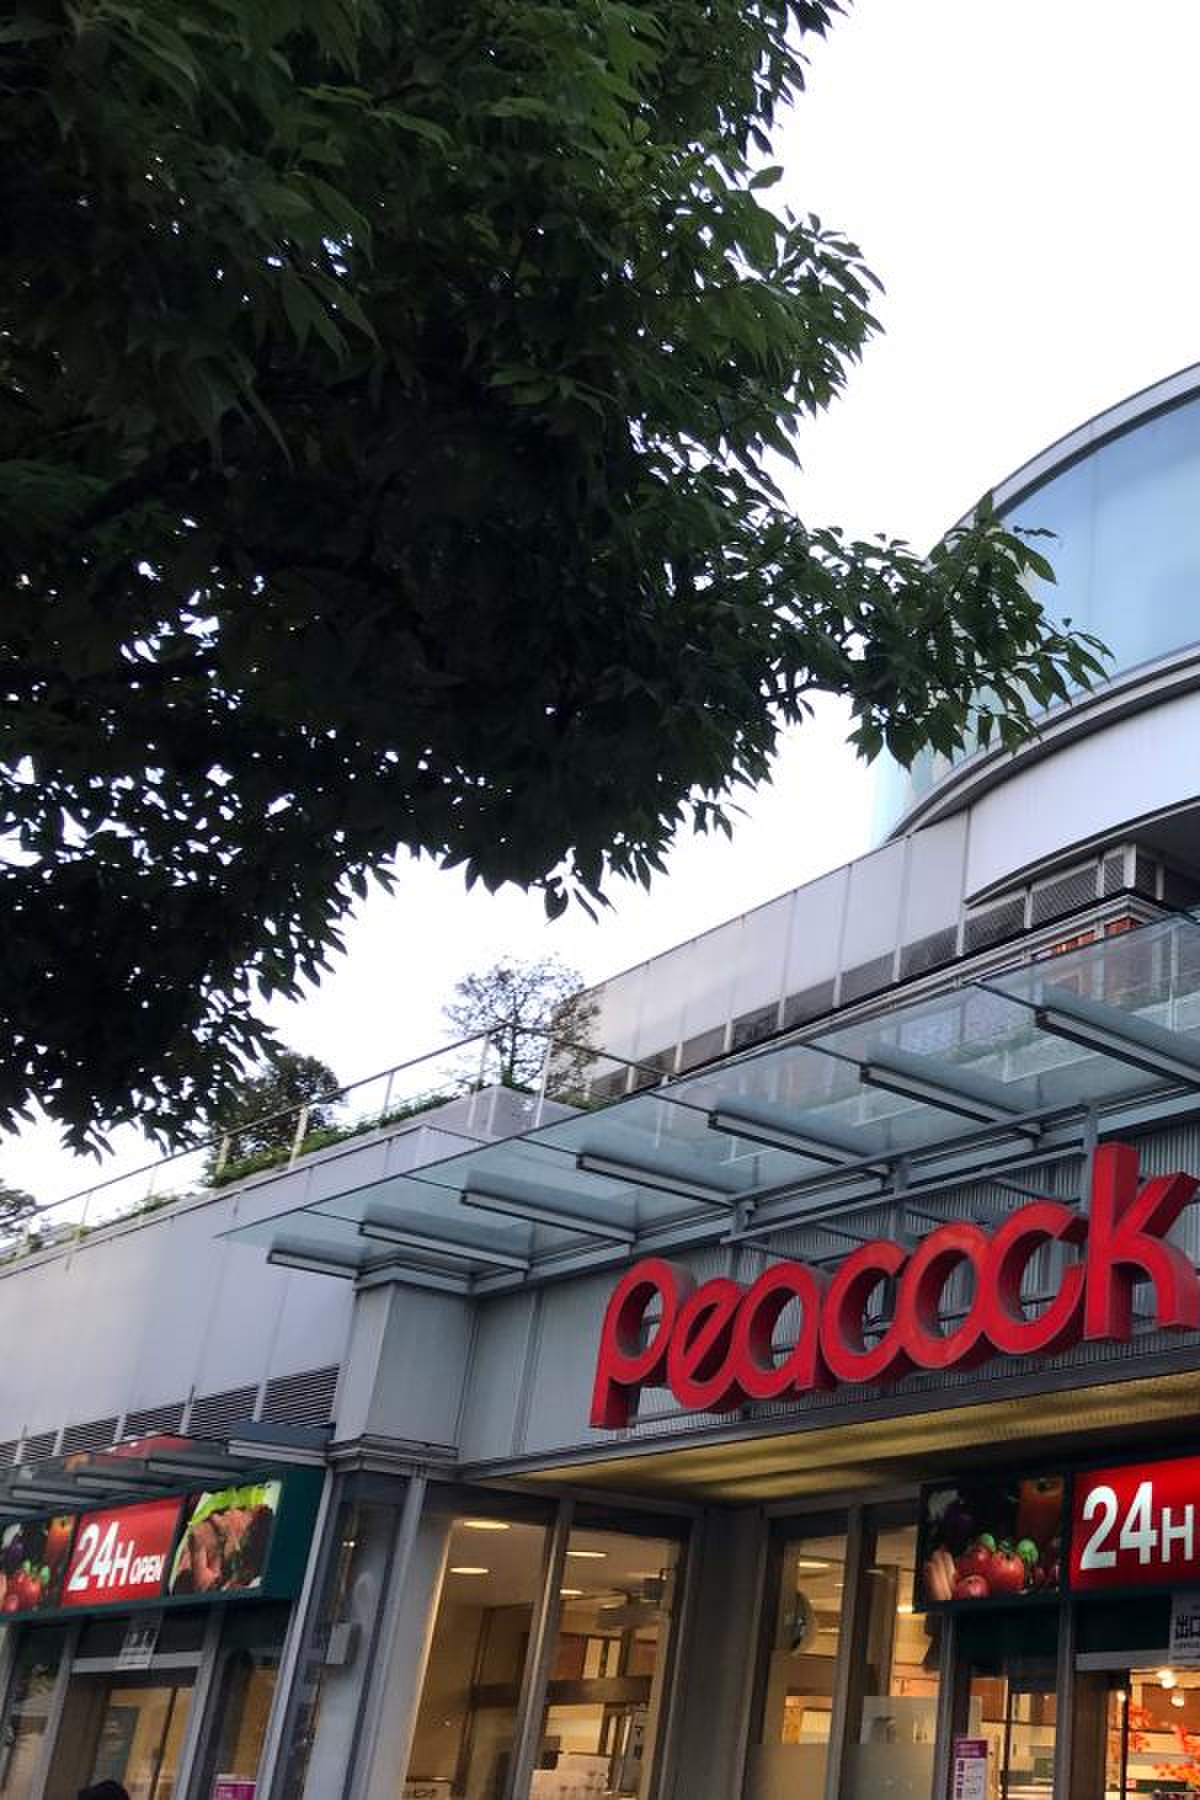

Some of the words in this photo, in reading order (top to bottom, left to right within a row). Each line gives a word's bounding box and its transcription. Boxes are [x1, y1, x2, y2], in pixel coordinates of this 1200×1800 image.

[67, 1521, 134, 1591] 24H
[129, 1553, 166, 1585] OPEN
[1079, 1481, 1195, 1571] 24H
